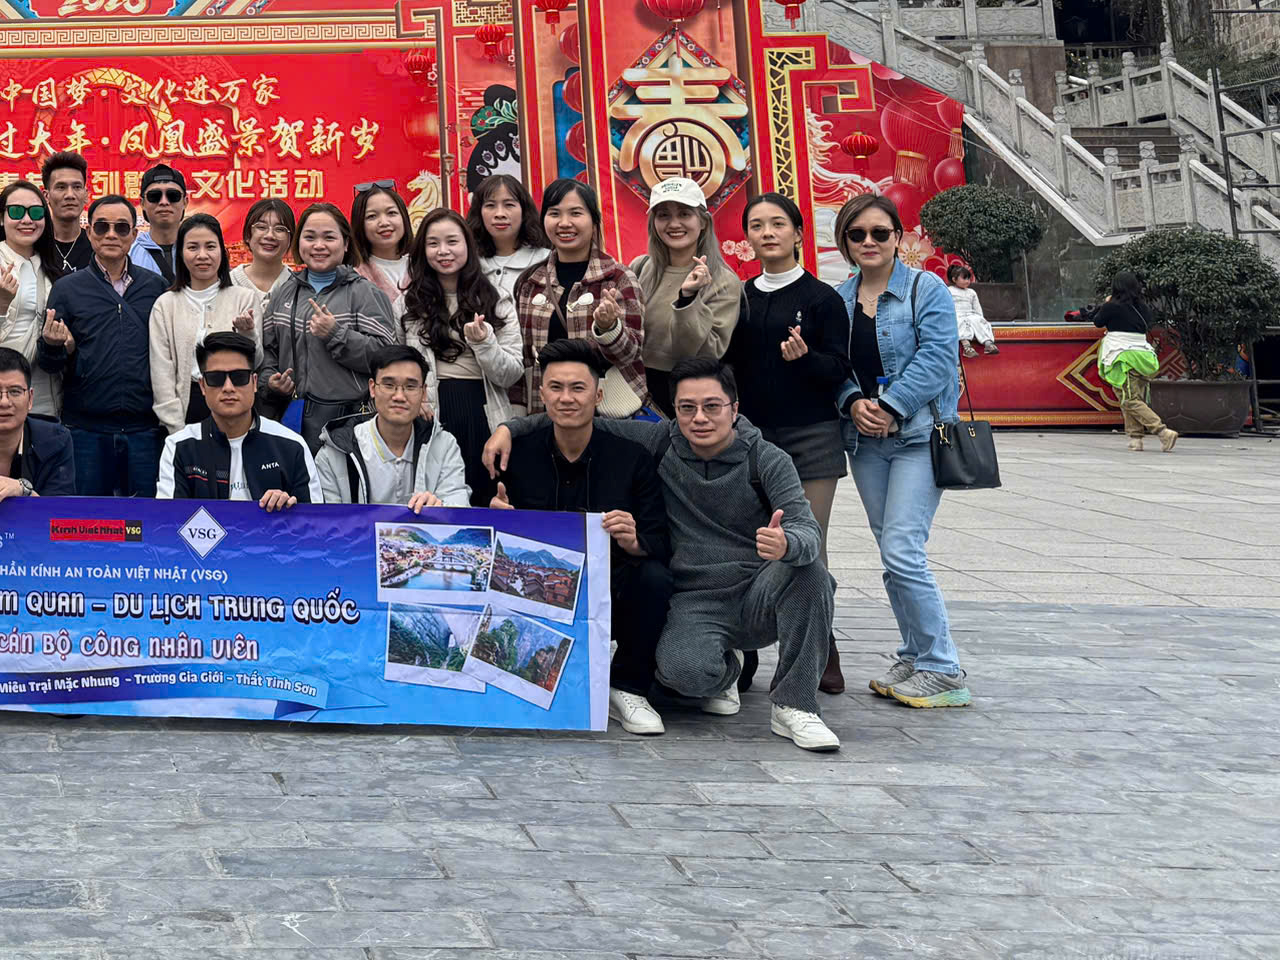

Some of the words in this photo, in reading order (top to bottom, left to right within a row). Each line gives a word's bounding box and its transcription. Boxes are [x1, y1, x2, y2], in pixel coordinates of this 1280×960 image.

[261, 461, 280, 470] ANTA
[51, 526, 78, 534] Kinh
[100, 527, 124, 535] Nhat
[125, 526, 141, 535] VSG
[187, 528, 217, 540] VSG
[30, 563, 61, 578] KÍNH
[64, 567, 83, 578] AN
[86, 564, 121, 579] TOÀN
[125, 565, 150, 582] VIỆT
[154, 566, 187, 583] NHẬT
[191, 569, 228, 583] (VSG)
[26, 590, 85, 618] QUAN
[113, 593, 144, 618] DU
[150, 593, 202, 624] LỊCH
[208, 594, 286, 623] TRUNG
[292, 588, 361, 625] QUỐC
[42, 629, 72, 660] BỘ
[80, 629, 140, 657] CÔNG
[149, 631, 205, 659] NHÂN
[28, 679, 52, 694] Trại
[54, 677, 79, 692] Mặc
[81, 675, 120, 687] Nhung
[134, 672, 177, 684] Trương
[179, 671, 198, 683] Gia
[200, 670, 224, 683] Giới
[236, 671, 263, 687] Thất
[265, 676, 291, 690] Tinh
[293, 681, 317, 697] Sơn
